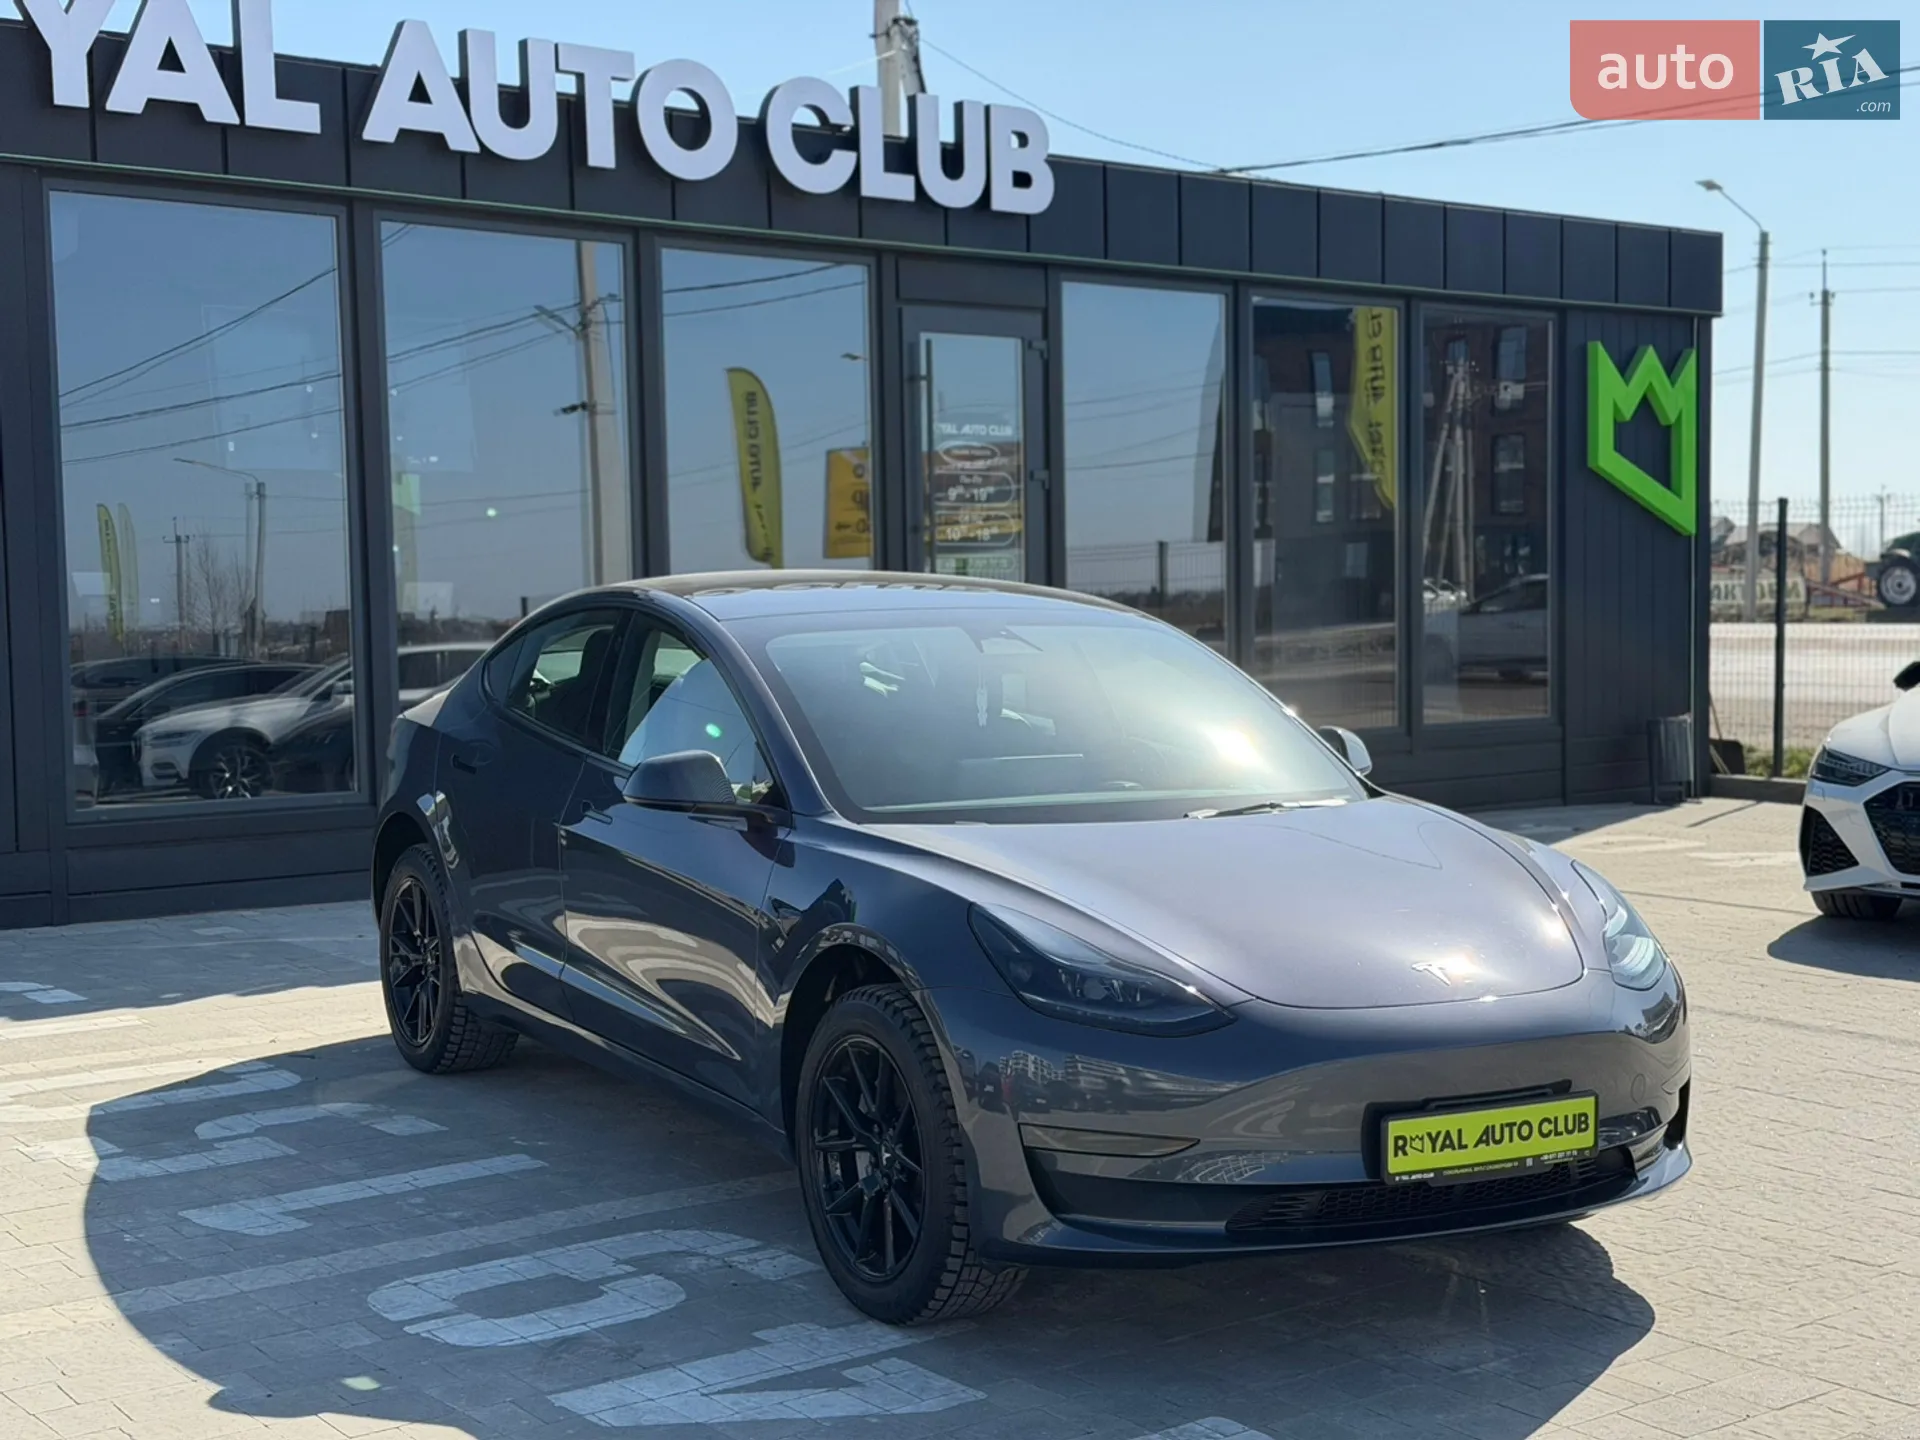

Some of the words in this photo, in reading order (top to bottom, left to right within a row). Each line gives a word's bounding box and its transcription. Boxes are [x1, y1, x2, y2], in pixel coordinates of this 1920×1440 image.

[362, 19, 738, 180] AUTO
[760, 76, 1056, 216] CLUB
[1473, 1119, 1533, 1148] AUTO
[1537, 1112, 1590, 1141] CLUB
